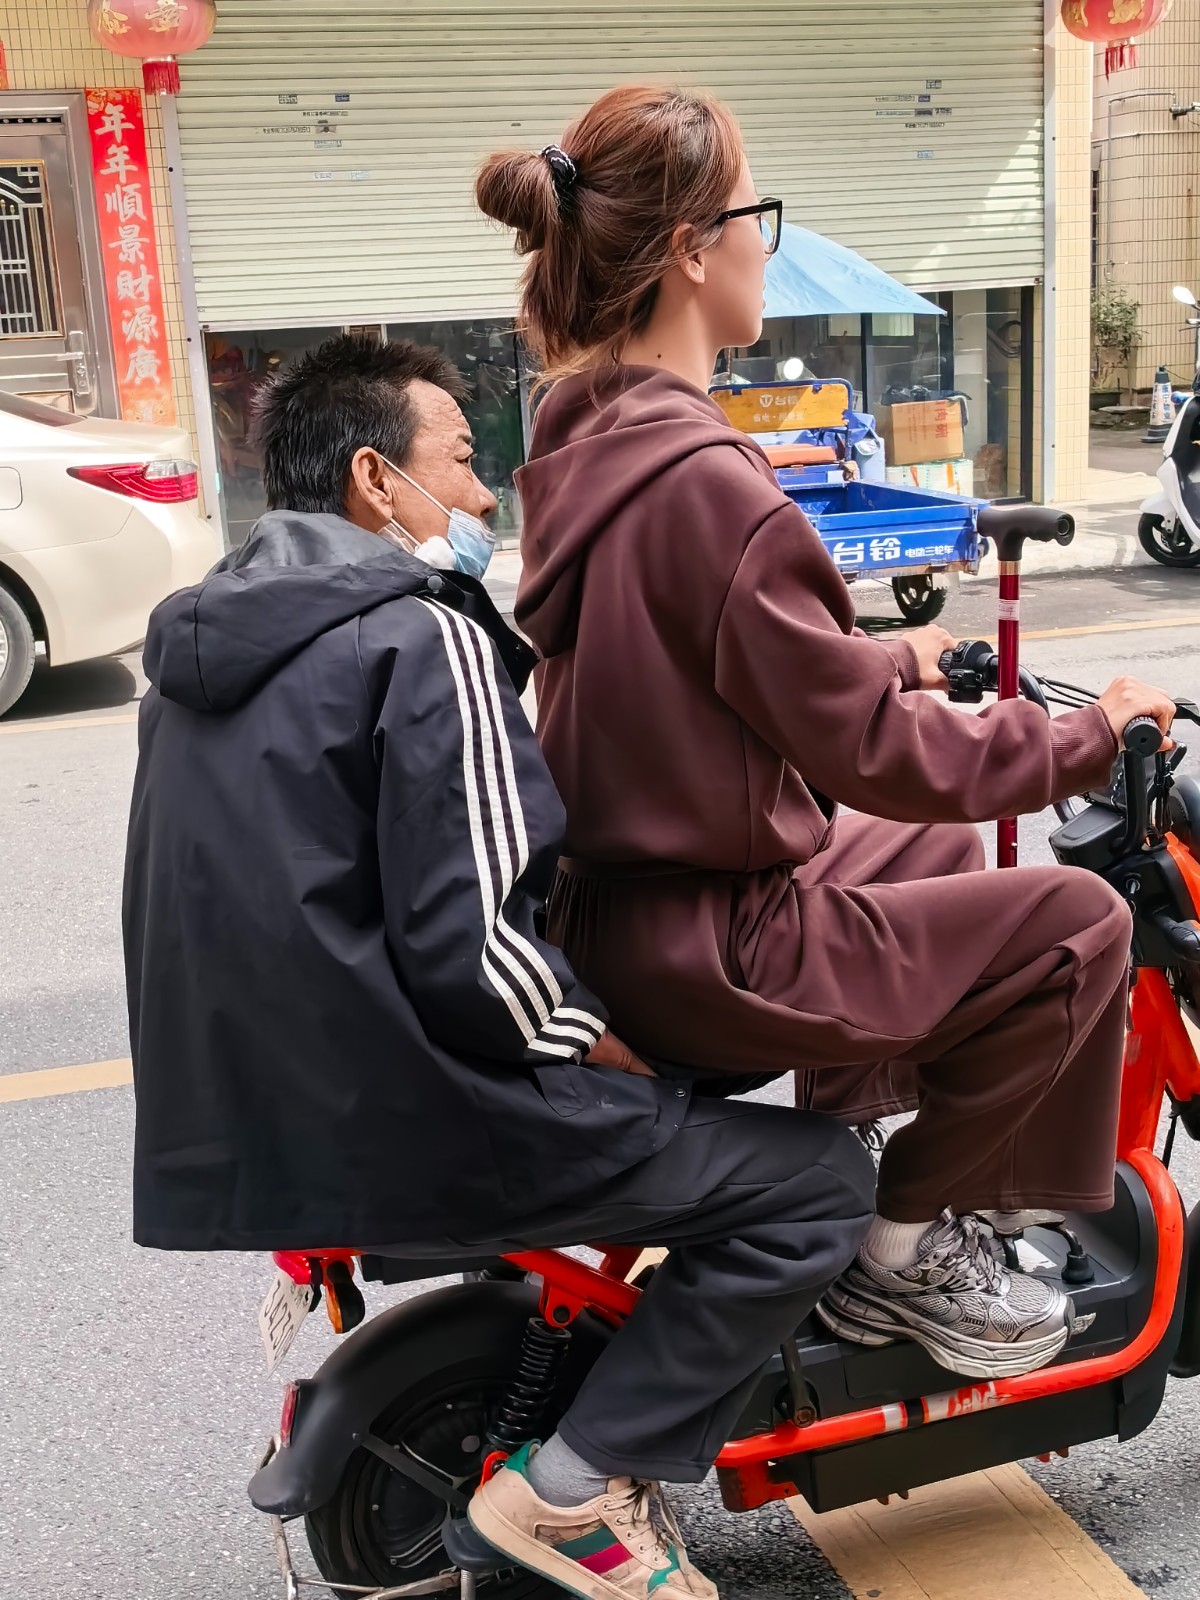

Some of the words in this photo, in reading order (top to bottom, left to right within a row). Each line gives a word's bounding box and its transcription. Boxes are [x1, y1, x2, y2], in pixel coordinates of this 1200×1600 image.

[94, 103, 162, 387] 年年順景財源廣
[833, 537, 902, 565] 台铃
[905, 545, 955, 558] 电动三轮车
